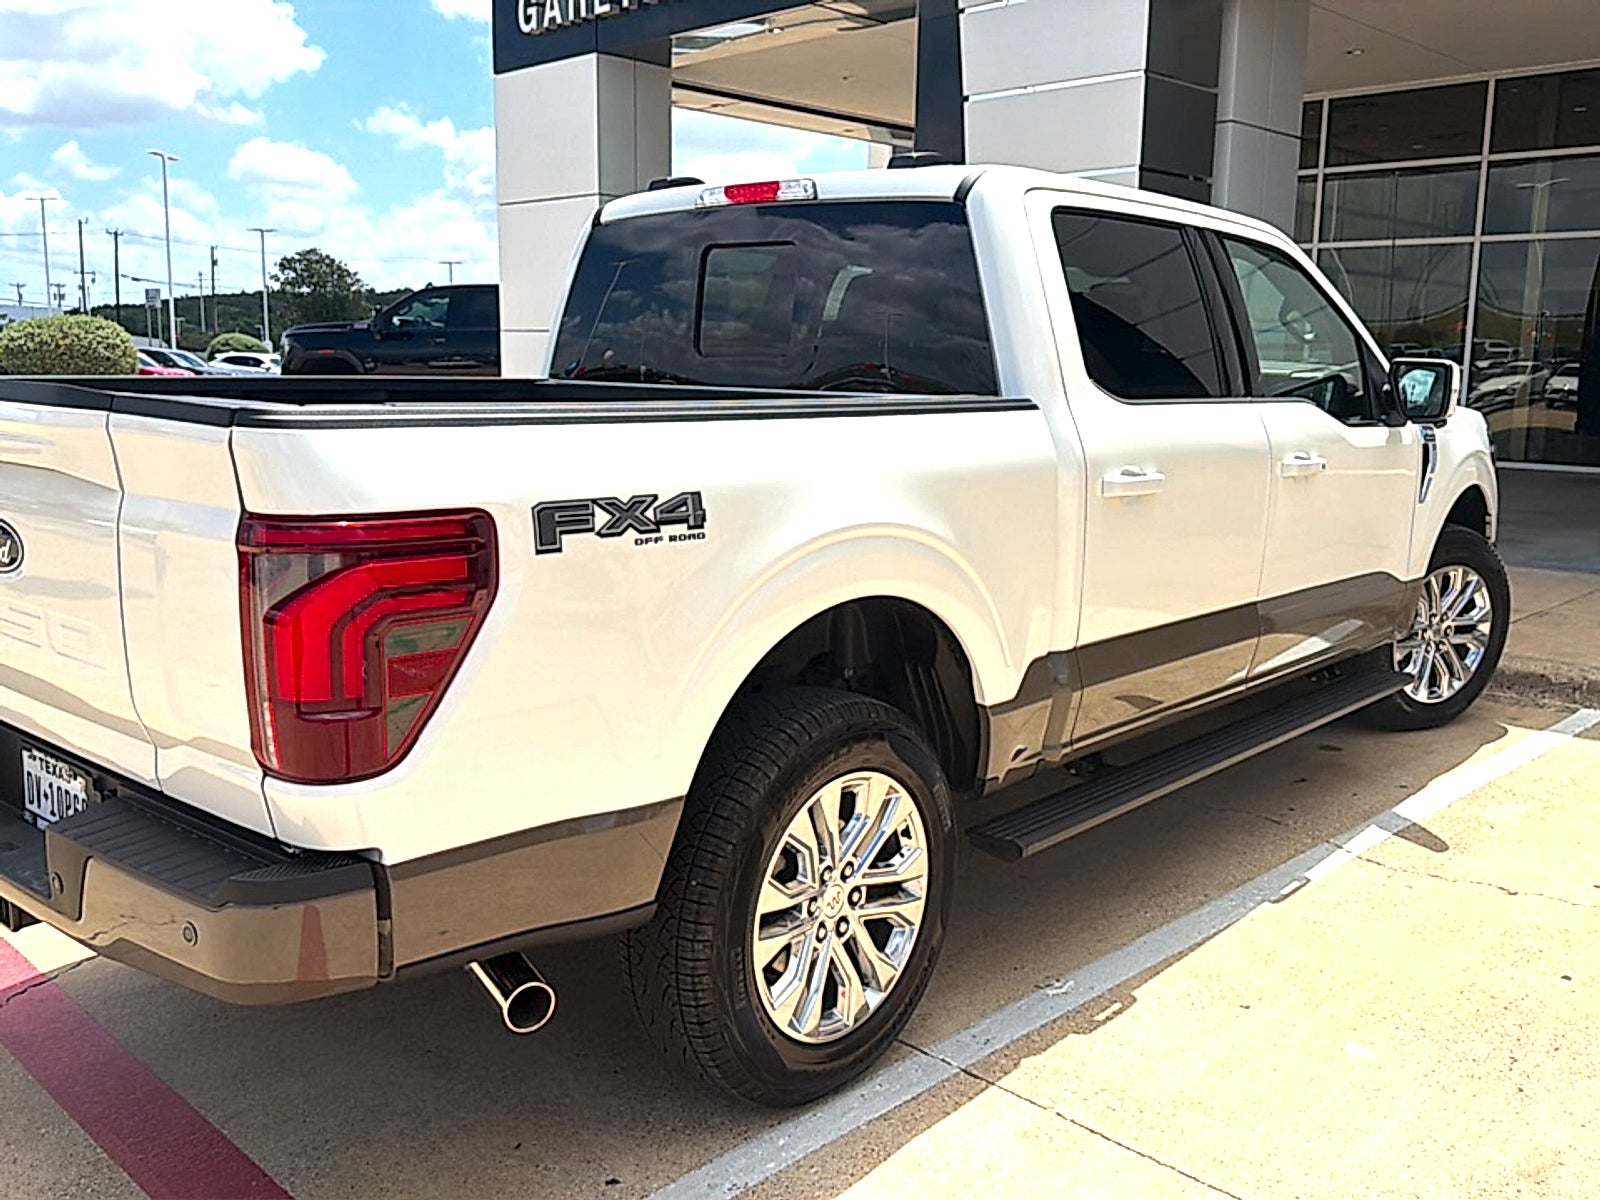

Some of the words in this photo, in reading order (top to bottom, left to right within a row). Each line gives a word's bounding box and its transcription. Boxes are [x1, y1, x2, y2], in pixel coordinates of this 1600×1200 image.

[531, 491, 706, 555] FX4
[634, 535, 663, 546] OFF
[668, 531, 706, 543] ROAD
